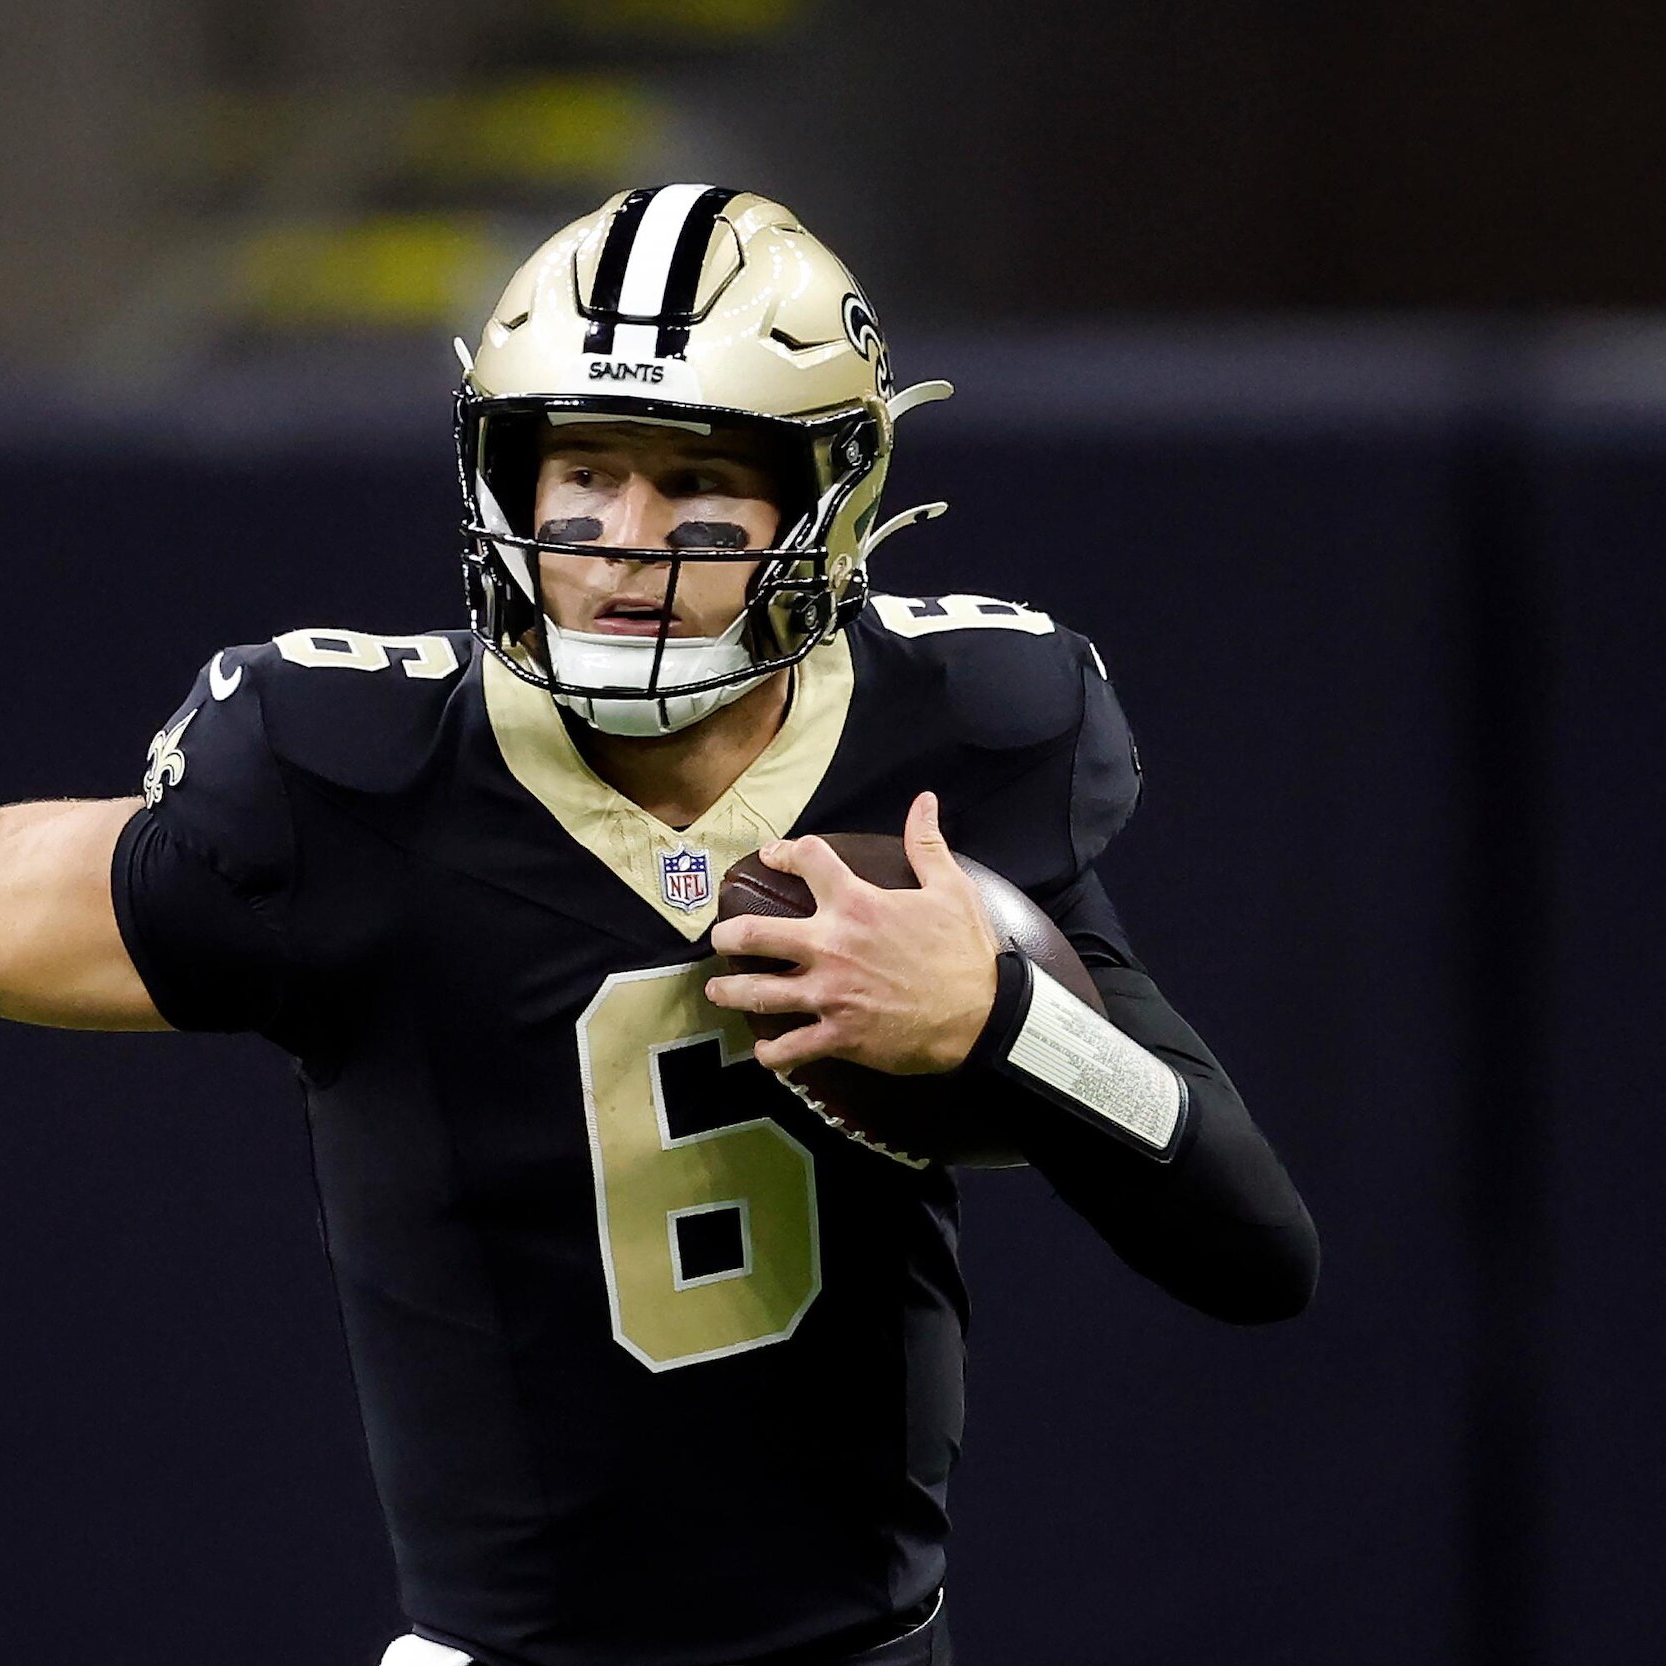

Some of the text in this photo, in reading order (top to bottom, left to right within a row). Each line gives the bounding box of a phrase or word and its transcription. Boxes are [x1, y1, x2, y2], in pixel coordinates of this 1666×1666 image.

[589, 361, 664, 384] SAINTS
[870, 594, 1056, 638] 6
[271, 628, 459, 679] 6
[669, 874, 705, 900] NFL
[575, 957, 823, 1374] 6
